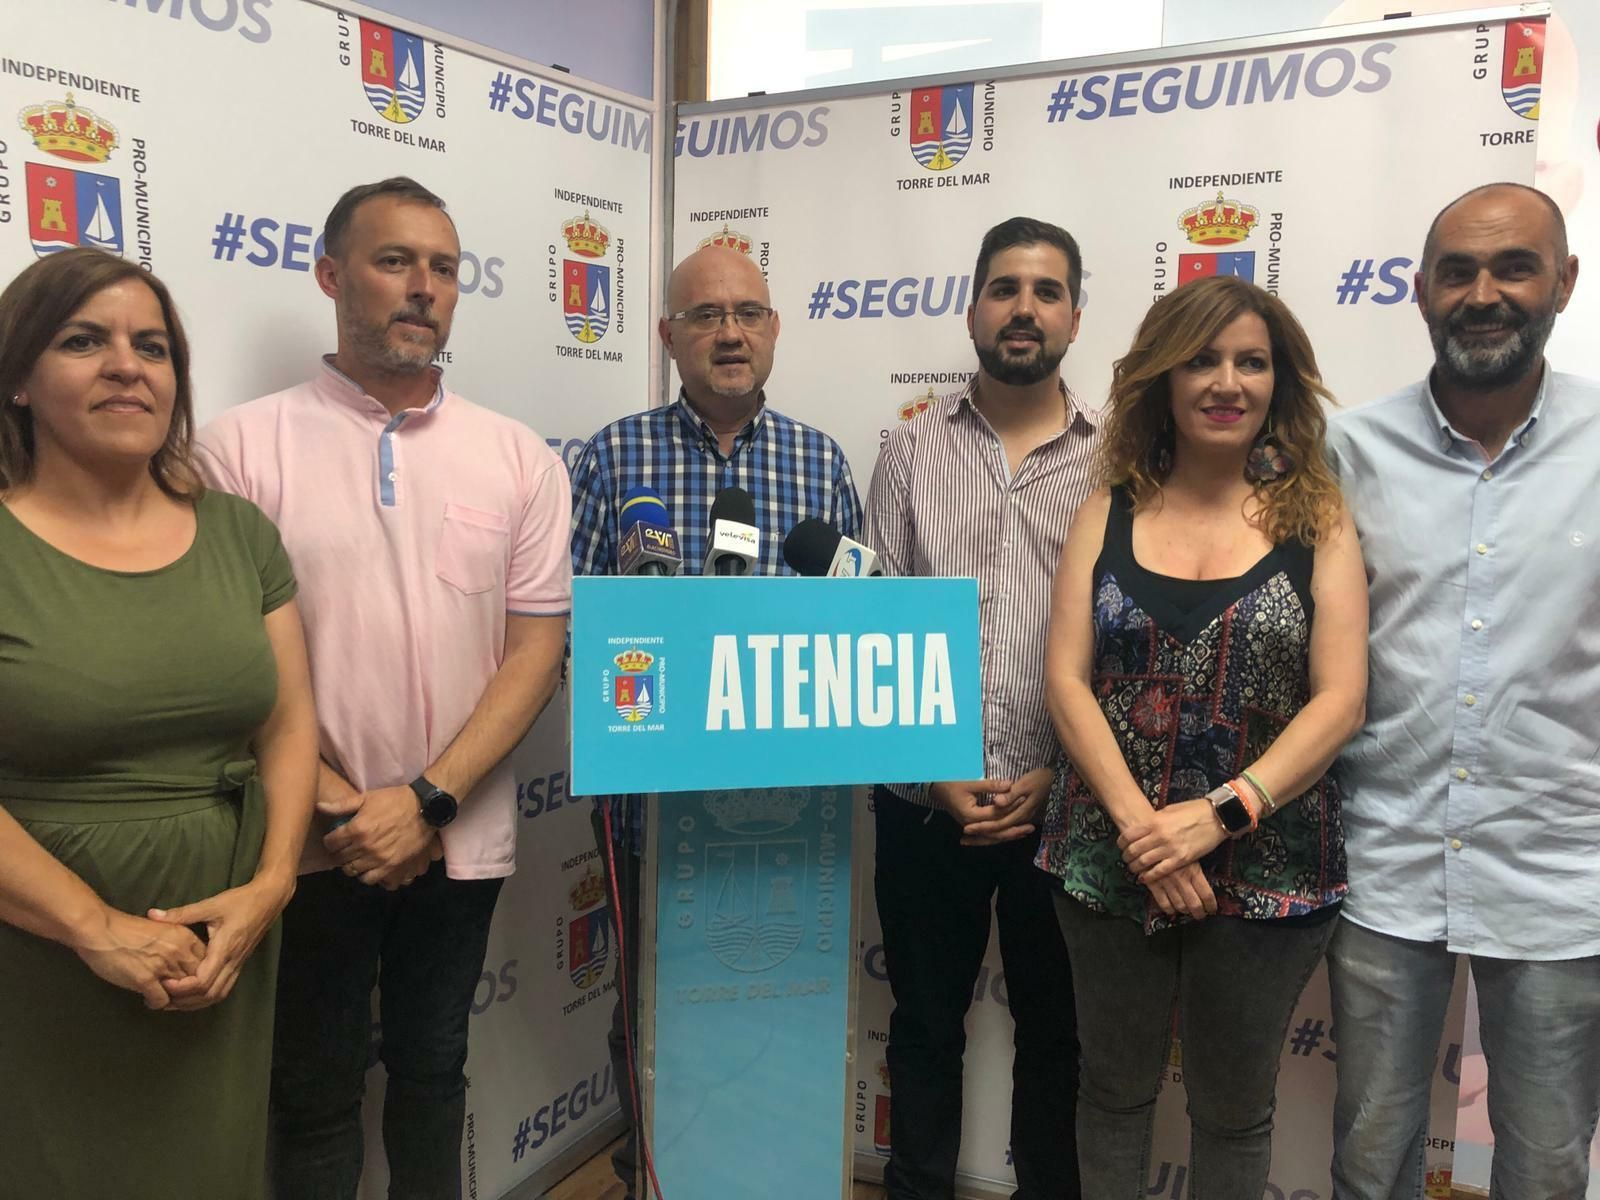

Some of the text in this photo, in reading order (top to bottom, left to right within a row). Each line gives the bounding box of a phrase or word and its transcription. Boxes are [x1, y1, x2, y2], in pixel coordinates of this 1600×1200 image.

[2, 58, 141, 103] INDEPENDIENTE
[1047, 42, 1398, 123] #SEGUIMOS
[489, 71, 650, 154] #SEGUIM
[350, 120, 446, 153] TORRE DEL MAR
[1480, 129, 1535, 147] TORRE
[896, 173, 990, 190] TORRE DEL MAR
[1169, 170, 1283, 189] INDEPENDIENTE
[554, 188, 623, 214] INDEPENDIENTE
[690, 207, 769, 222] INDEPENDIENTE
[616, 238, 624, 333] PRO-MUNICIPIO
[556, 345, 623, 362] TORRE DEL MAR
[890, 372, 976, 384] INDEPENDIENT
[608, 637, 664, 645] INDEPENDIENTE
[602, 669, 610, 703] GRUPO
[706, 633, 956, 731] ATENCIA
[608, 723, 664, 733] TORRE DEL MAR
[677, 815, 696, 930] GRUPO
[816, 789, 837, 952] RO-MUNICIPIO
[556, 915, 565, 970] GRUPO
[563, 995, 586, 1016] TORRE
[586, 987, 601, 1003] DEL
[855, 1080, 867, 1133] GRUPO
